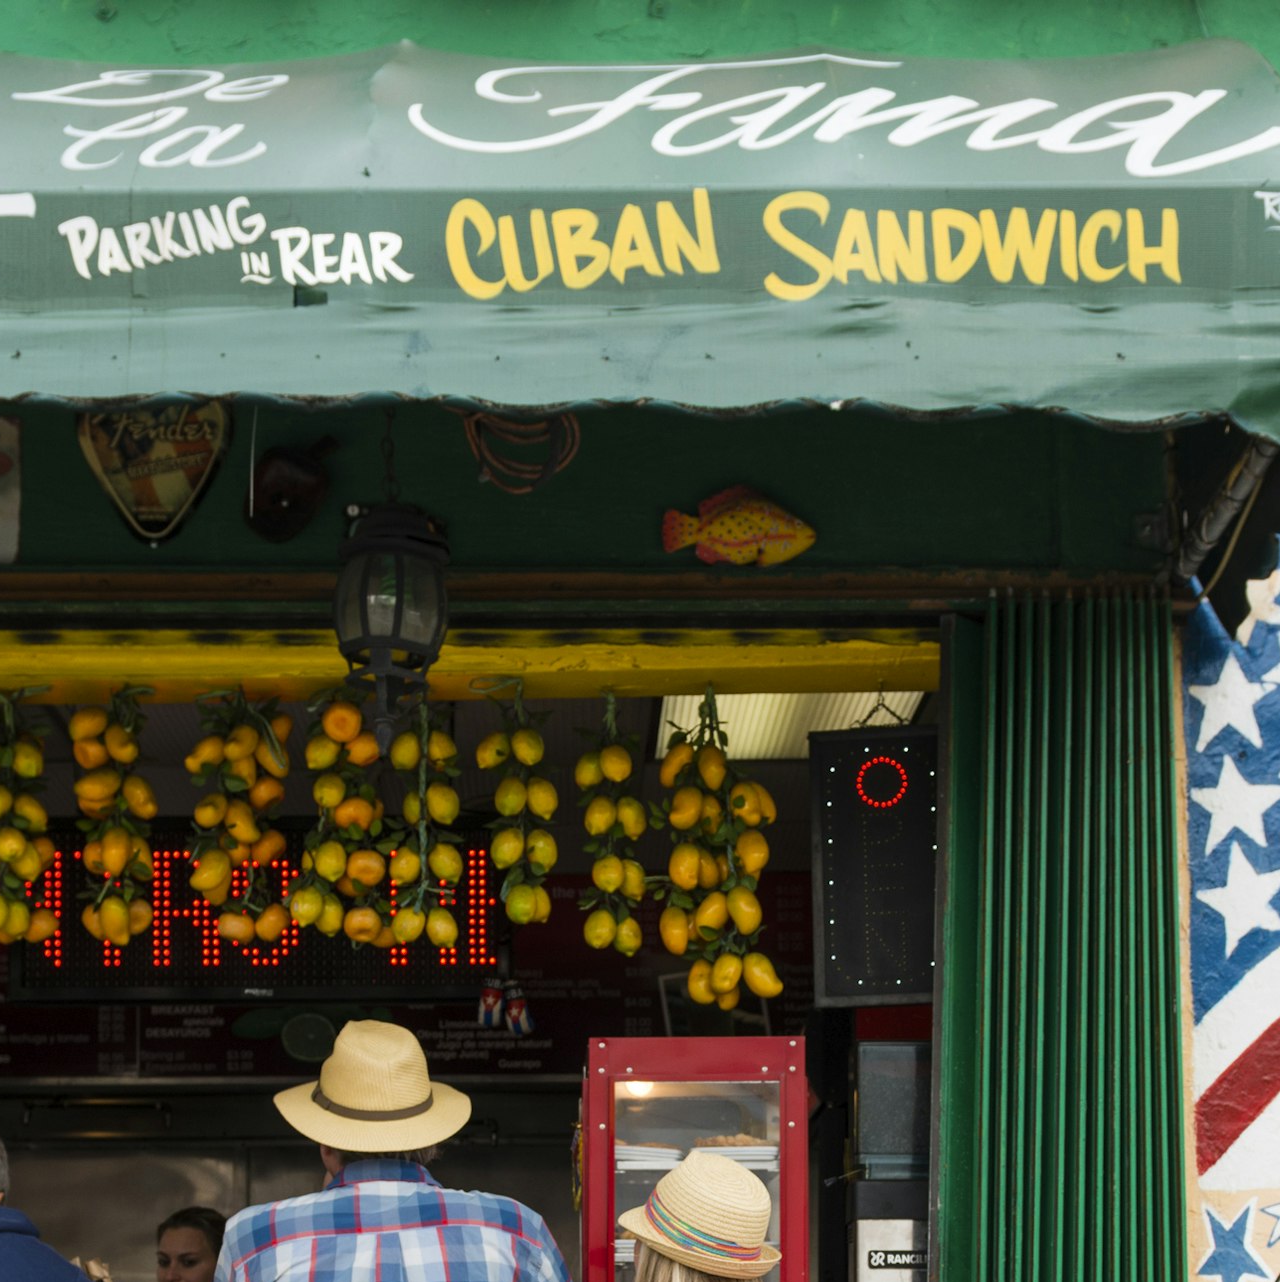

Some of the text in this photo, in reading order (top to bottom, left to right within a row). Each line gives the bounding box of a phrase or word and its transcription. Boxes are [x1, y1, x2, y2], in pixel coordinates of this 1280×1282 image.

[58, 196, 265, 280] PARKING
[241, 250, 274, 279] IN
[271, 226, 415, 287] REAR
[445, 187, 1183, 302] CUBAN SANDWICH
